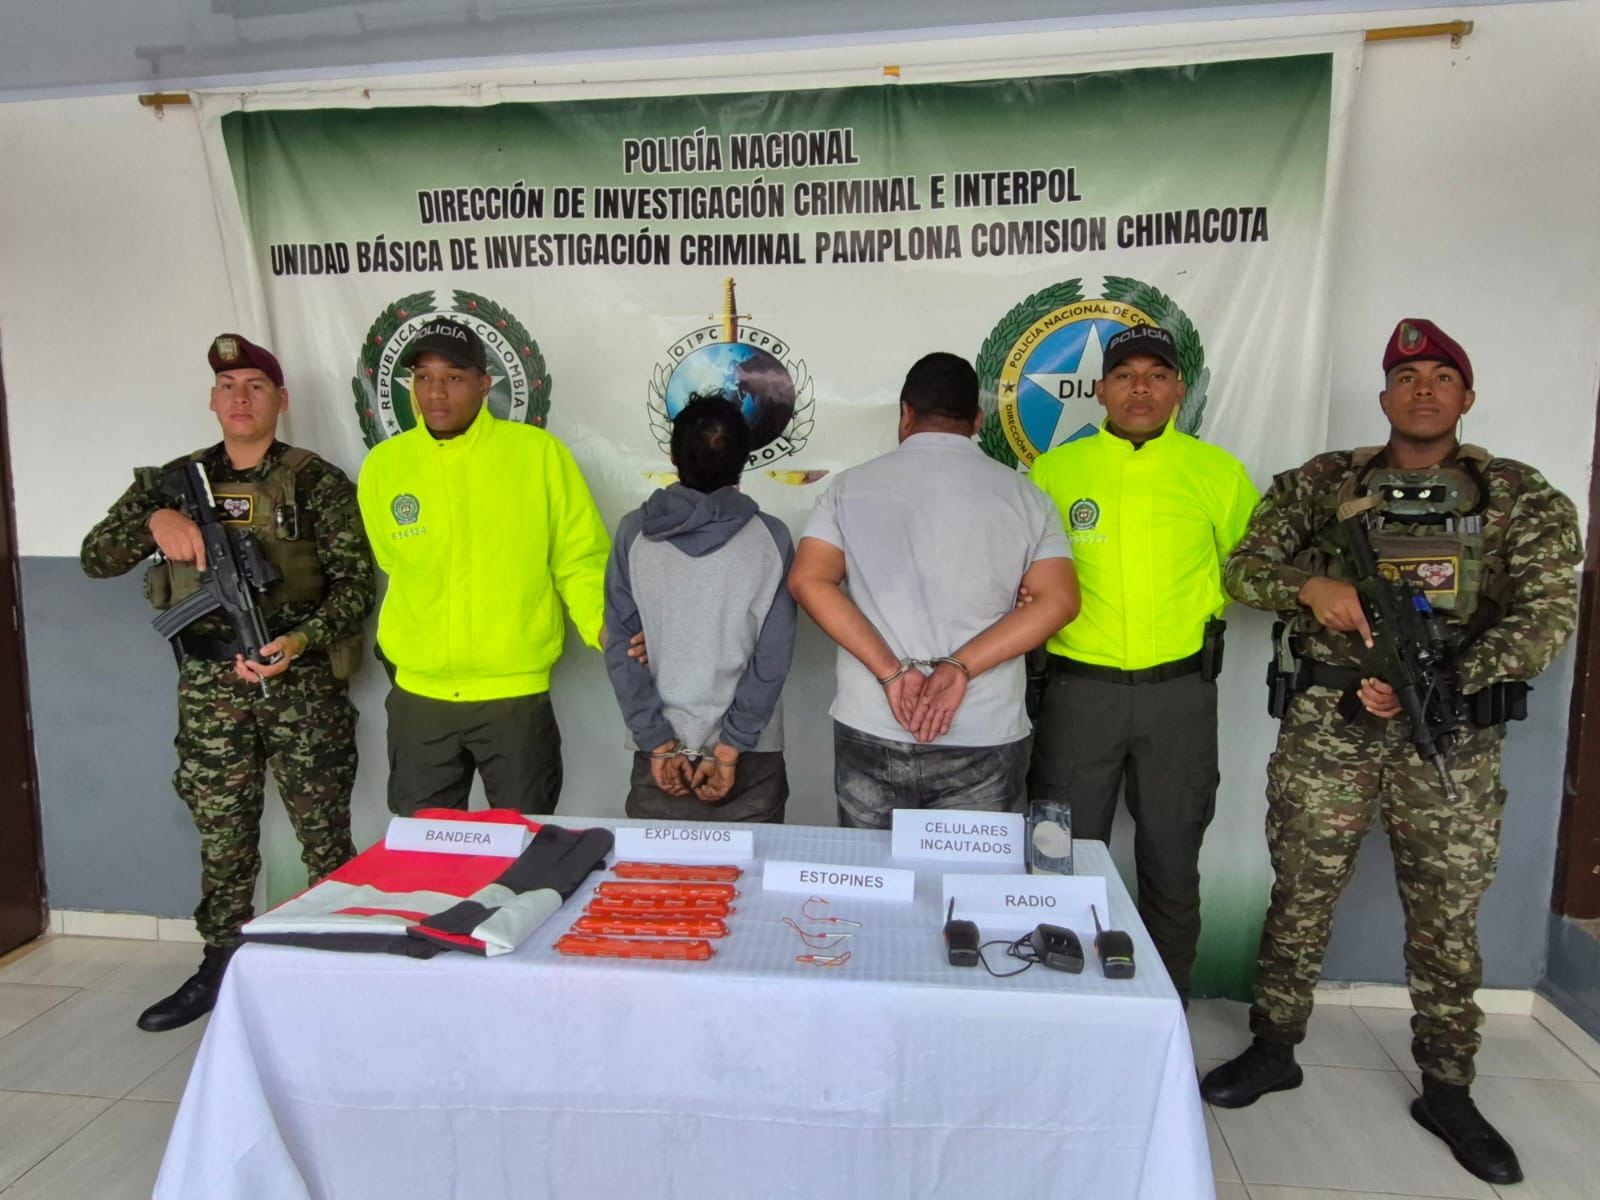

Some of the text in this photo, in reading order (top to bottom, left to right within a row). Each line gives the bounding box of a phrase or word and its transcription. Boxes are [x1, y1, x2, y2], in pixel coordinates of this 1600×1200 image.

[624, 128, 859, 173] POLICÍA NACIONAL
[418, 167, 1082, 224] DIRECCIÓN DE INVESTIGACIÓN CRIMINAL E INTERPOL
[270, 206, 1269, 276] UNIDAD BÁSICA DE INVESTIGACIÓN CRIMINAL PAMPLONA COMISION CHINACOTA
[1043, 304, 1109, 330] NACIONAL
[1112, 306, 1129, 318] DE
[674, 328, 784, 357] OIPC ICPO
[475, 324, 525, 408] COLOMBIA
[1059, 379, 1096, 399] DIJ
[425, 829, 492, 845] BANDERA
[644, 827, 731, 843] EXPLOSIVOS
[924, 822, 1009, 838] CELULARES
[920, 838, 1012, 855] INCAUTADOS
[799, 870, 884, 889] ESTOPINES
[1005, 894, 1057, 908] RADIO
